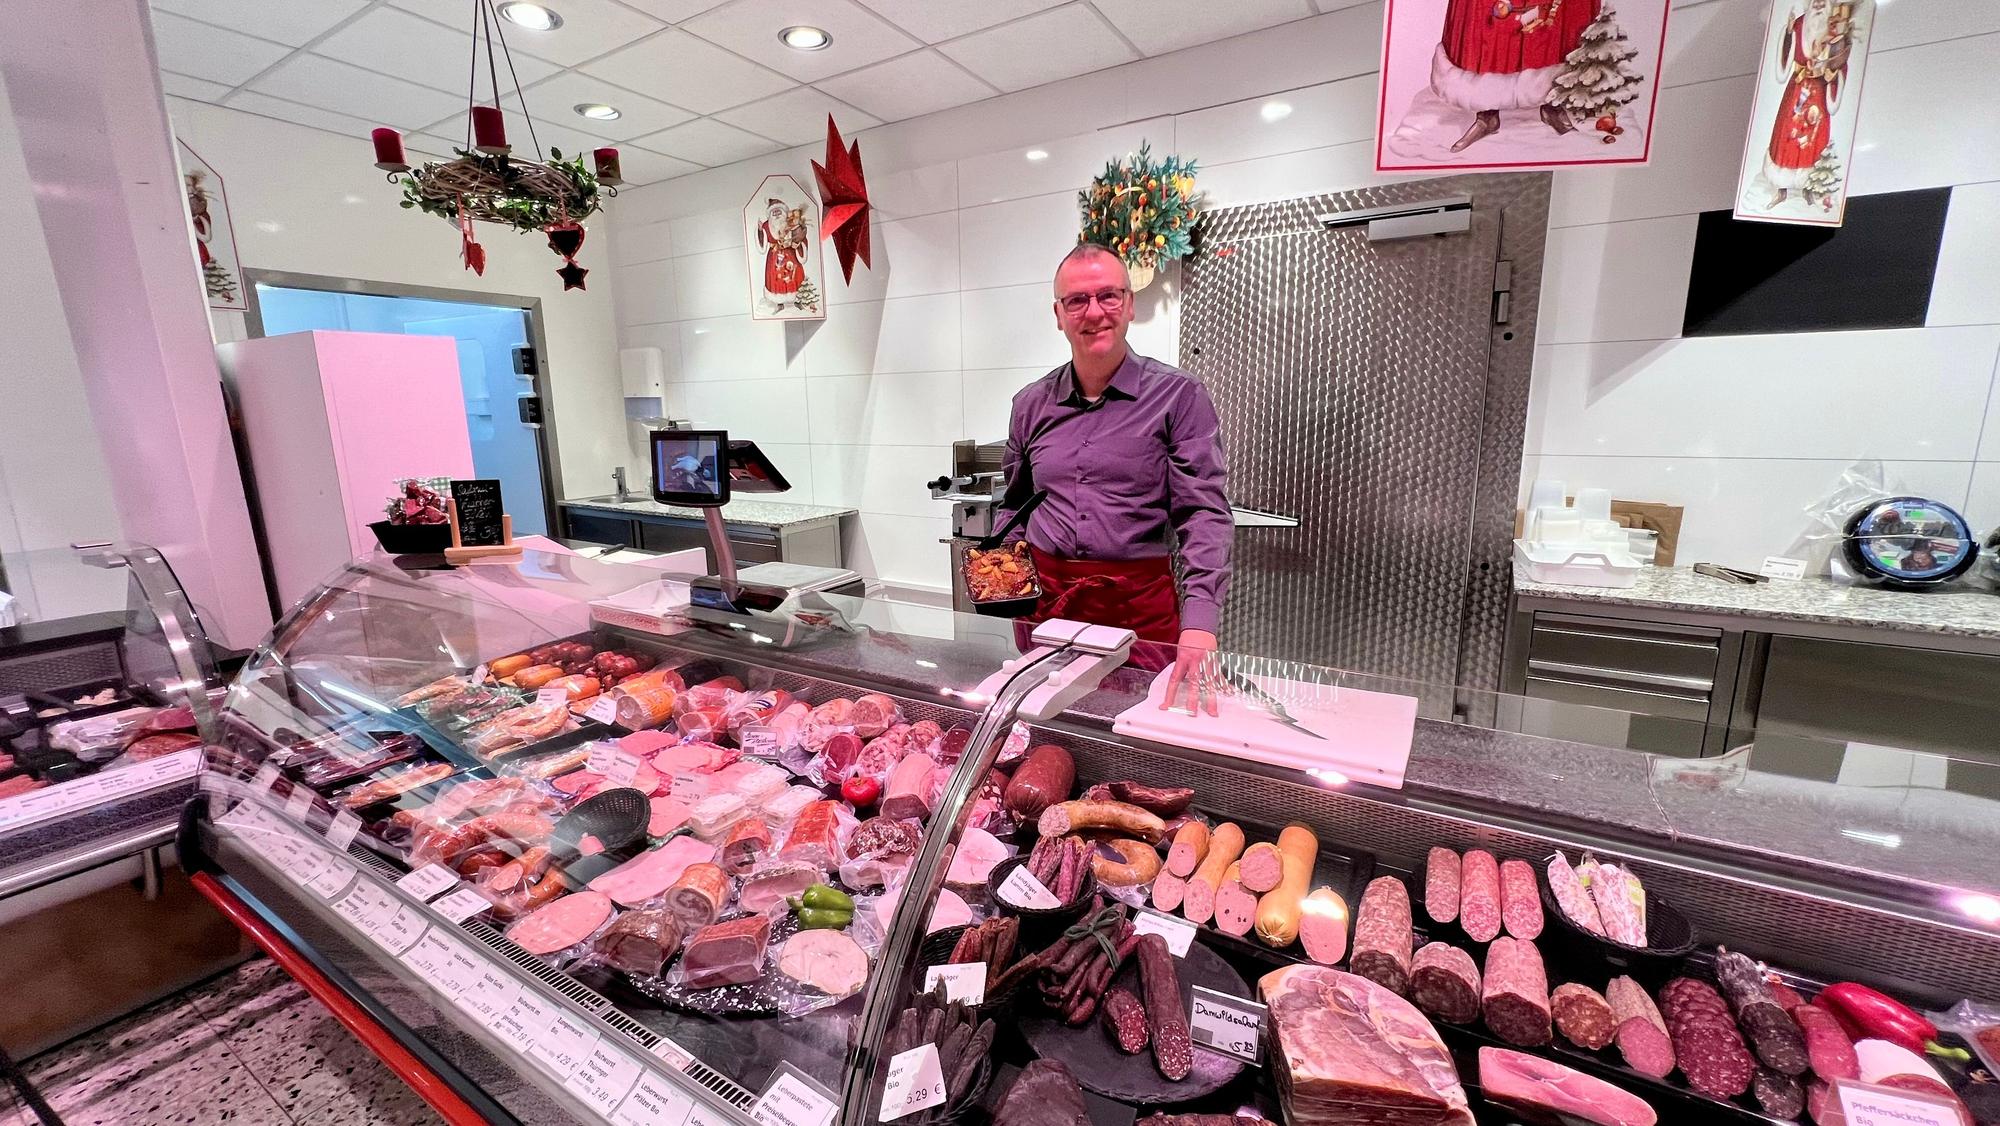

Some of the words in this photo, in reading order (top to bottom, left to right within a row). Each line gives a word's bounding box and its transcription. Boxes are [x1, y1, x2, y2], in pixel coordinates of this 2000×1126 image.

[1015, 873, 1037, 895] Landjäger
[1024, 891, 1032, 901] Bio
[510, 1005, 521, 1017] Ring
[550, 1026, 559, 1035] Bio
[594, 1049, 616, 1069] Blutwurst
[569, 1062, 579, 1071] €
[587, 1060, 609, 1079] Thüringer
[579, 1069, 589, 1080] Art
[586, 1074, 595, 1084] Bio
[887, 1081, 900, 1090] Bio
[934, 1082, 942, 1095] €
[640, 1081, 669, 1105] Leberwurst
[769, 1093, 781, 1104] mit
[777, 1083, 814, 1111] Leberpastete
[607, 1098, 617, 1108] €
[633, 1093, 652, 1108] Pfälzer
[650, 1104, 660, 1115] Bio
[753, 1111, 765, 1122] Bio
[1855, 1115, 1874, 1126] Bio
